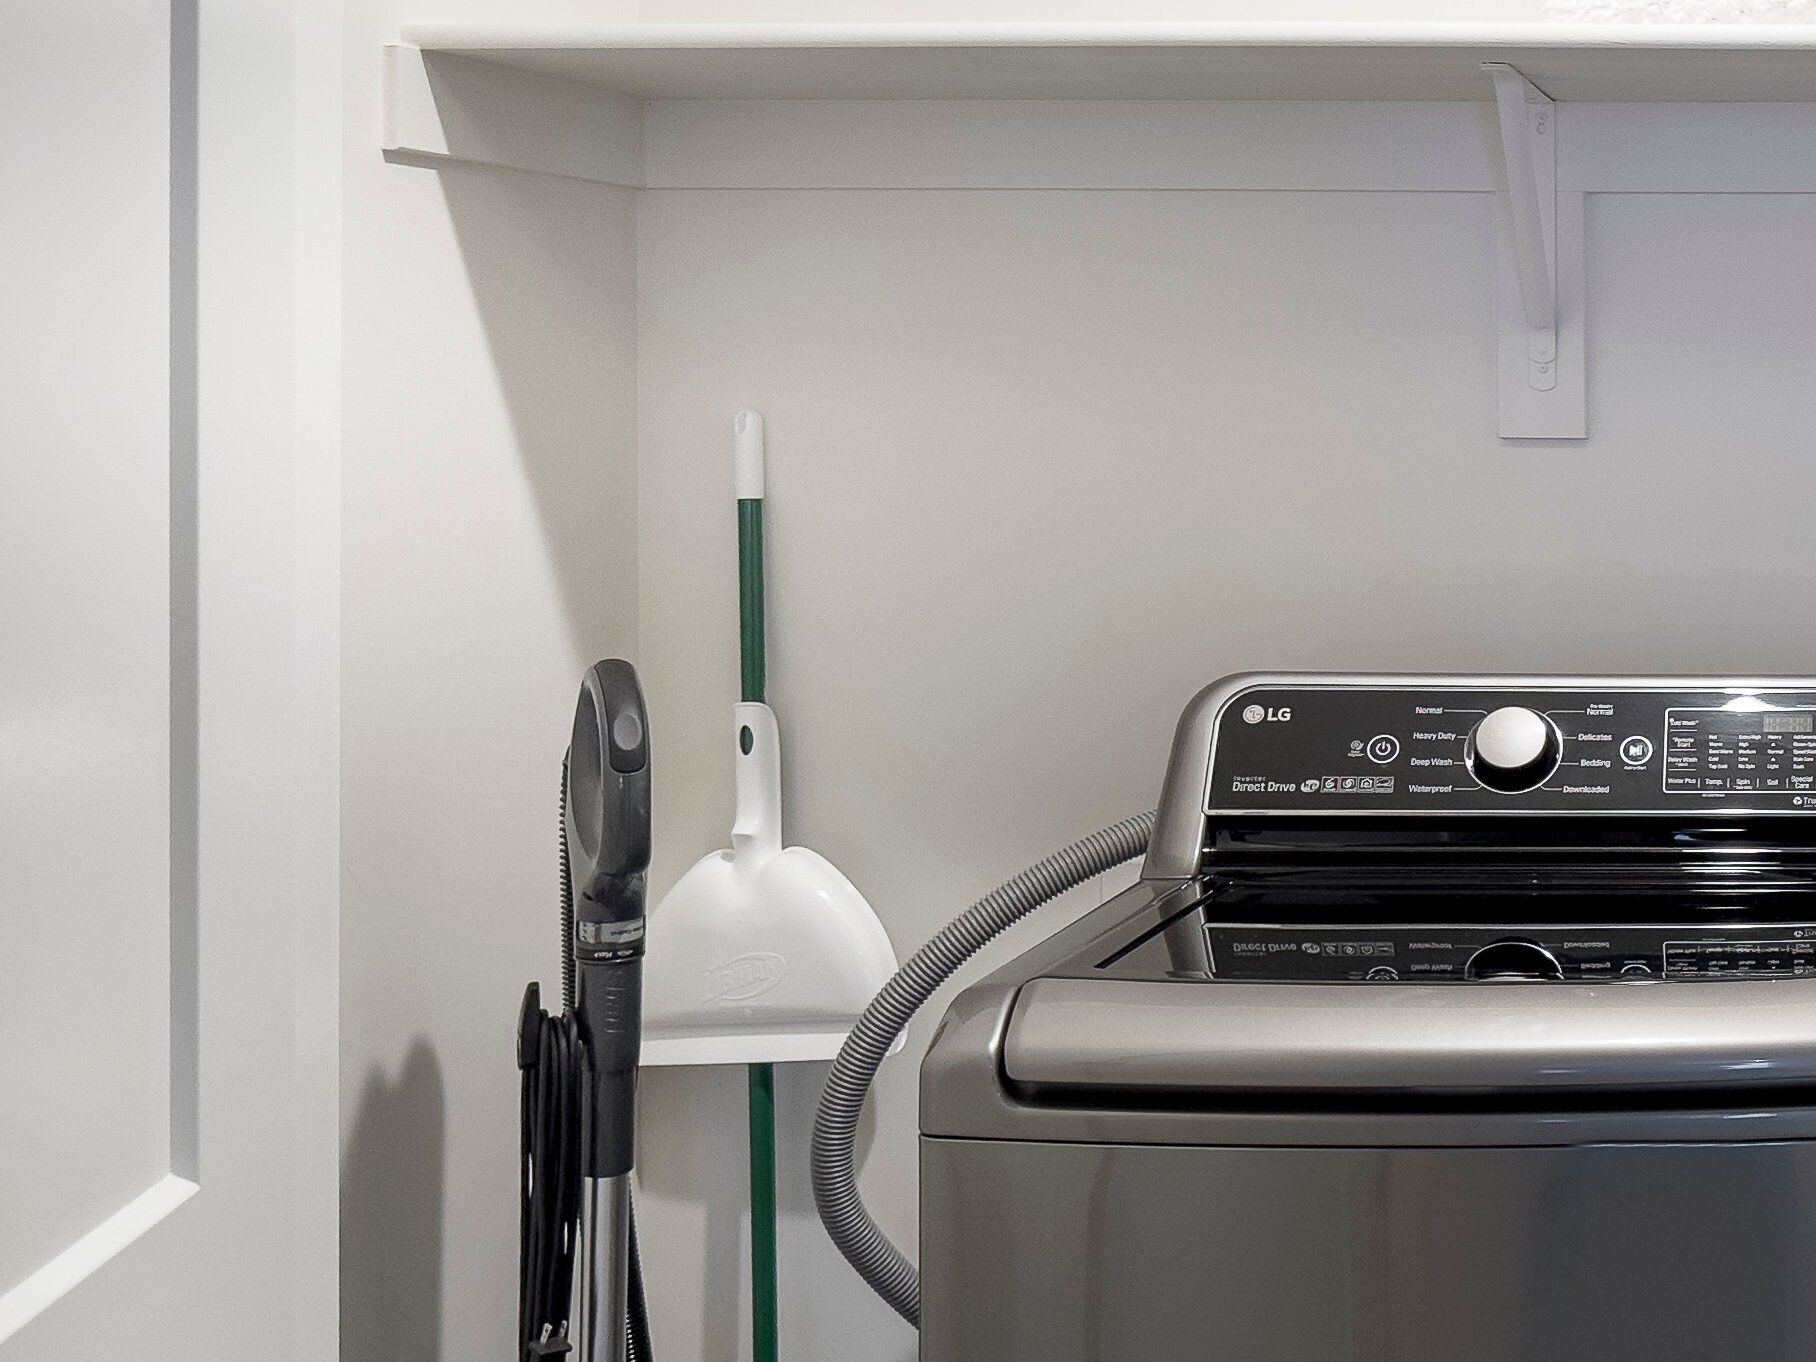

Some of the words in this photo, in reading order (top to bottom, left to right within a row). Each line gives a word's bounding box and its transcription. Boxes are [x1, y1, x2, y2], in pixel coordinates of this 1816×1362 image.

[1267, 708, 1291, 721] LG
[1413, 732, 1436, 741] Heavy
[1438, 732, 1456, 741] Duty
[1411, 758, 1429, 767] Deep
[1581, 759, 1610, 768] Bedding
[1232, 782, 1265, 792] Direct
[1268, 782, 1295, 792] Drive
[1409, 785, 1452, 793] Waterproof
